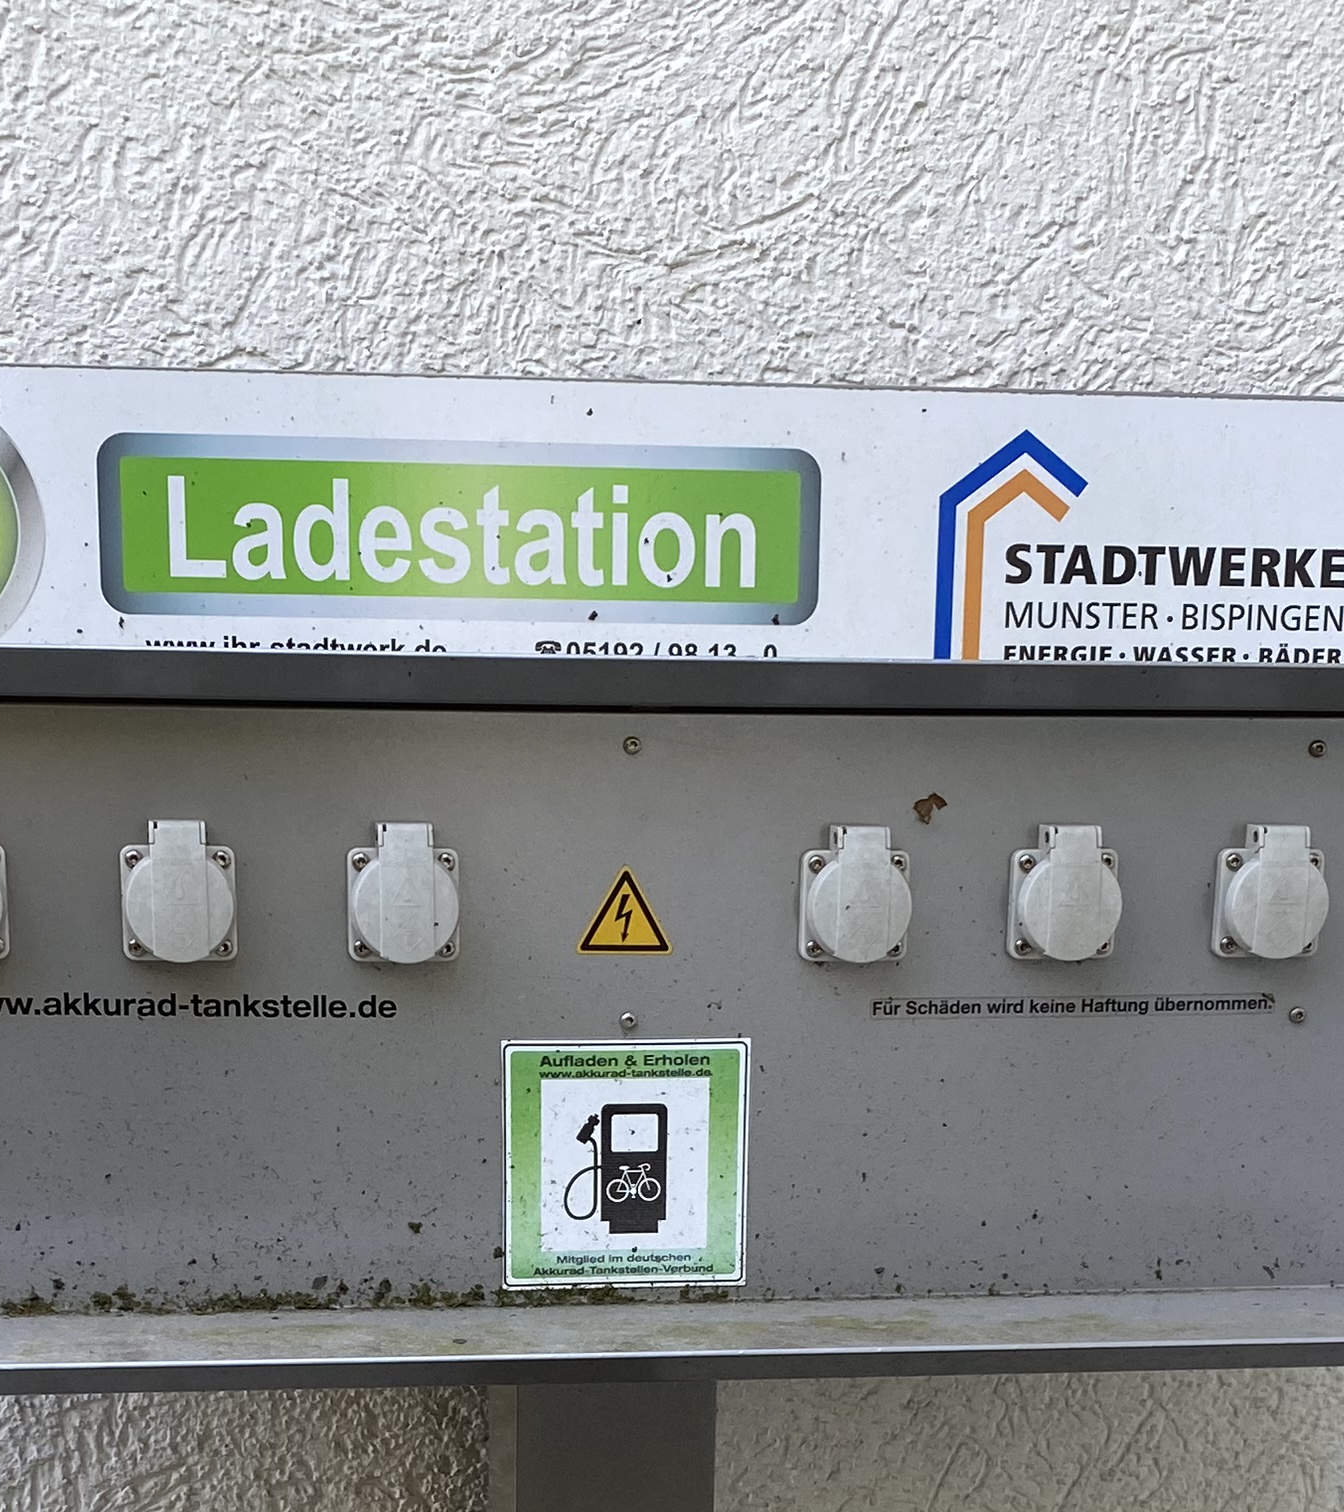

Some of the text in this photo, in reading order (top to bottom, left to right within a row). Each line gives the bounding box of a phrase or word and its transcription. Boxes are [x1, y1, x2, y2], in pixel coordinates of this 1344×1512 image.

[167, 475, 757, 589] Ladestation
[1004, 601, 1158, 630] MUNSTER
[1181, 603, 1344, 632] BISPINGEN
[872, 996, 1273, 1016] Für Schäden wird keine Haftung übernommen.
[540, 1054, 710, 1067] Aufladen & Erholen
[557, 1253, 691, 1264] Mitglied im deutschen
